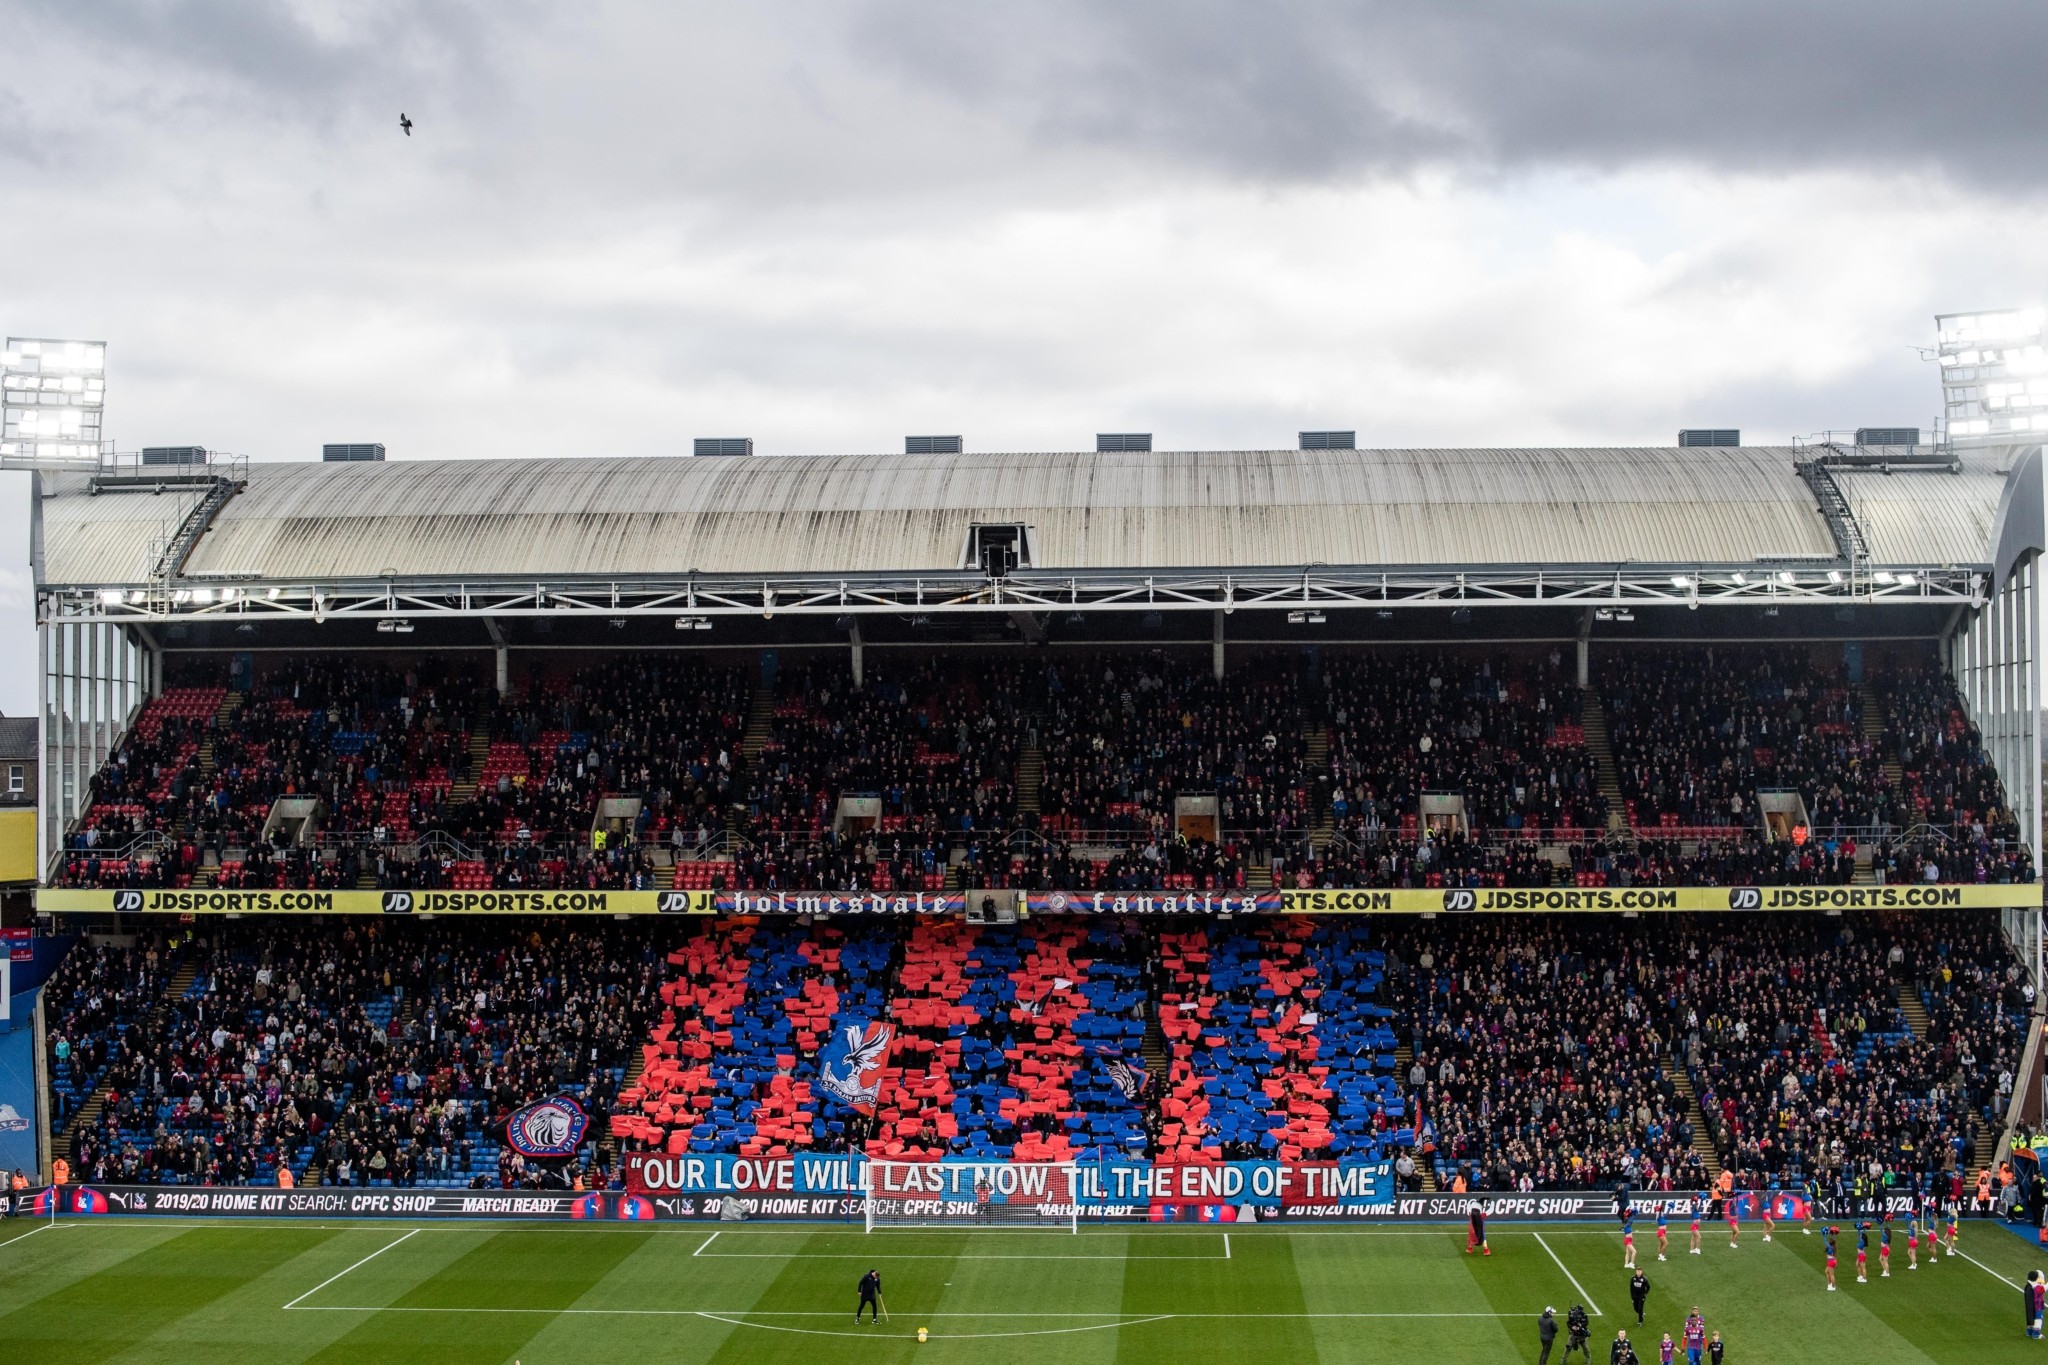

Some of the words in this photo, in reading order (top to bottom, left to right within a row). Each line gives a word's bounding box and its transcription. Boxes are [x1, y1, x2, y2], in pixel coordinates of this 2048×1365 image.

[117, 891, 141, 909] JD
[149, 893, 332, 910] JDSPORTS.COM
[385, 892, 411, 911] JD
[418, 893, 607, 911] JDSPORTS.COM
[661, 893, 687, 911] JD
[734, 891, 947, 913] holmesdale
[1092, 892, 1257, 914] fanatics
[1447, 891, 1473, 910] JD
[1482, 890, 1676, 909] JDSPORTS.COM
[1737, 891, 1759, 908] JD
[1767, 888, 1961, 907] JDSPORTS.COM
[715, 1159, 794, 1190] LOVE
[803, 1160, 874, 1190] WILL
[884, 1165, 966, 1193] LAST
[1111, 1167, 1174, 1197] THE
[1182, 1166, 1244, 1197] END
[1252, 1166, 1293, 1197] OF
[155, 1193, 208, 1210] 2019/20
[211, 1195, 258, 1210] HOME
[260, 1195, 286, 1210] KIT
[288, 1195, 347, 1211] SEARCH:
[351, 1195, 389, 1211] CPFC
[392, 1195, 436, 1211] SHOP
[462, 1198, 511, 1212] MATCH
[513, 1199, 560, 1213] READY
[761, 1199, 808, 1214] HOME
[811, 1199, 838, 1214] KIT
[840, 1199, 899, 1214] SEARCH:
[904, 1200, 943, 1215] CPFC
[1399, 1199, 1426, 1215] KIT
[1495, 1199, 1535, 1214] CPFC
[1538, 1199, 1583, 1214] SHOP
